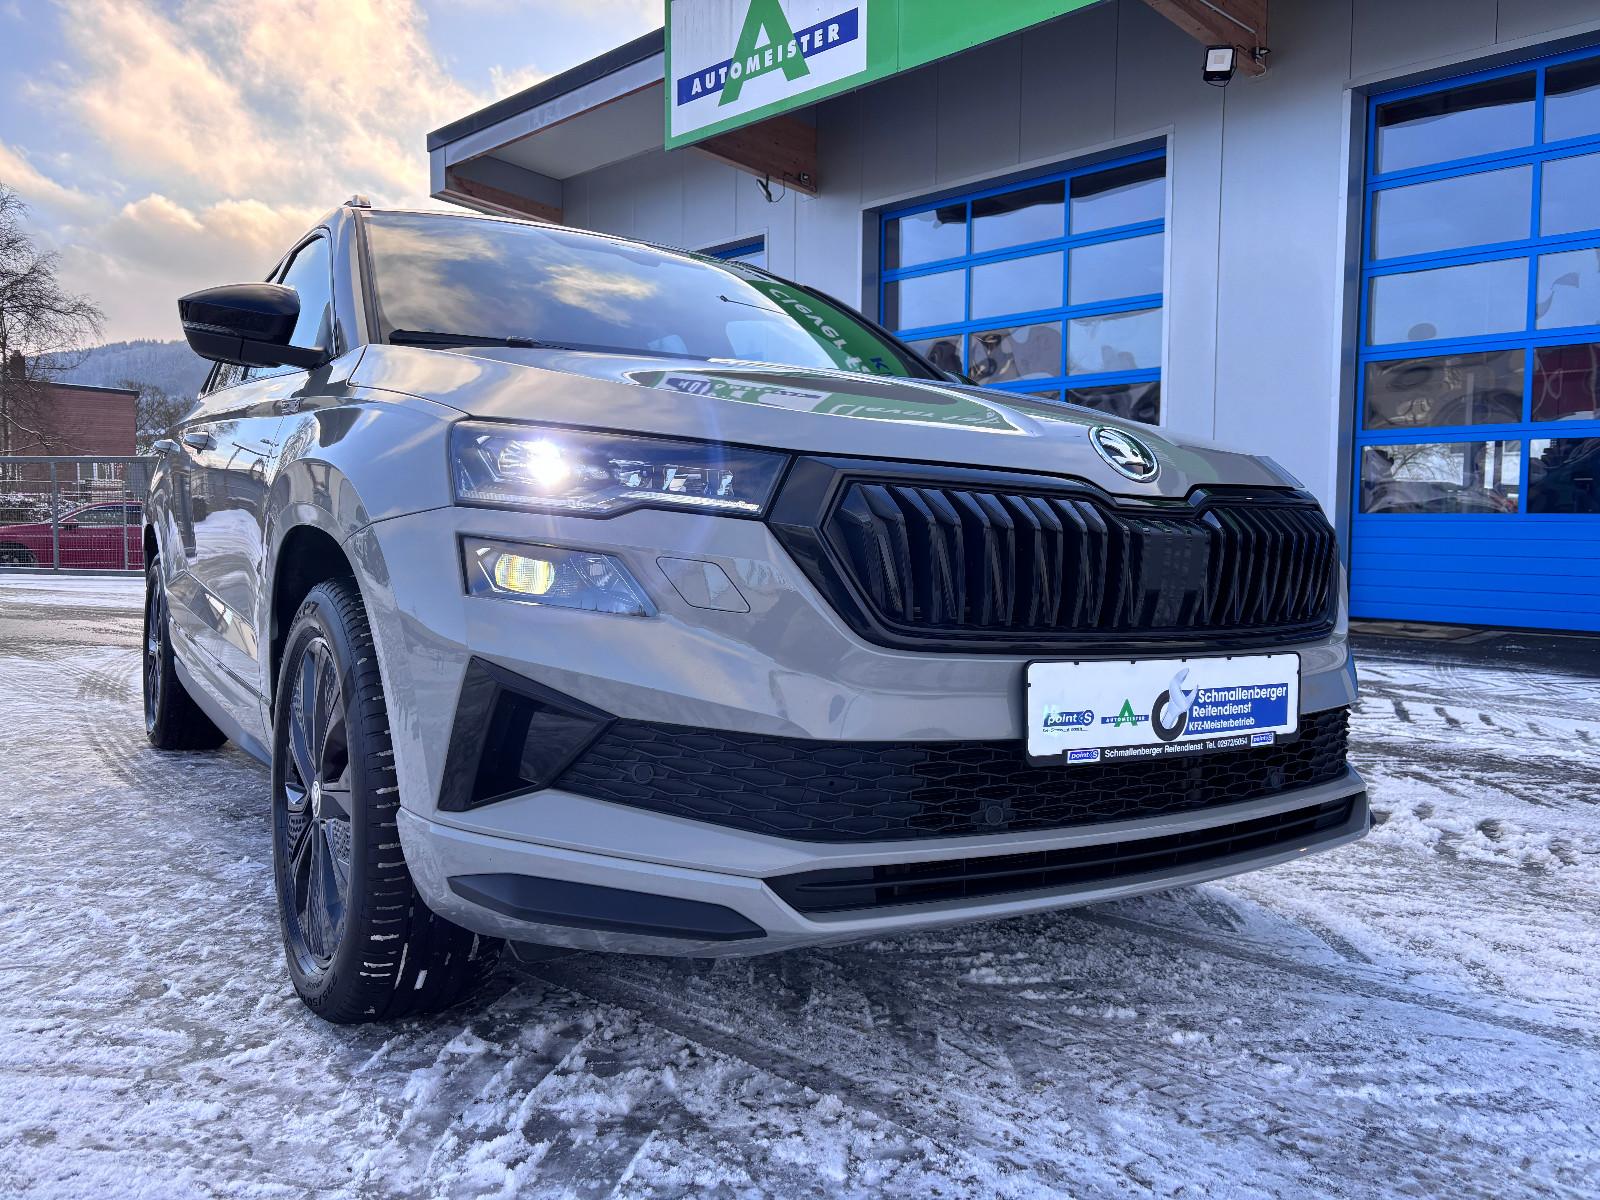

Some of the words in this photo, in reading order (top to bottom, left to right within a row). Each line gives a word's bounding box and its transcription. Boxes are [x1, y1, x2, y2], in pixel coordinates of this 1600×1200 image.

[691, 23, 840, 95] AUTOMEISTER
[1198, 685, 1287, 704] Schmallenberger
[1192, 702, 1252, 718] Reifendienst
[1047, 713, 1077, 725] point
[1105, 715, 1146, 723] AUTOMEISTER
[1189, 717, 1255, 731] KFZ-Meisterbetrieb
[1071, 751, 1089, 760] point
[1104, 746, 1163, 759] Schmallenberger
[1164, 742, 1204, 754] Reifendienst
[1206, 740, 1217, 749] Tel.
